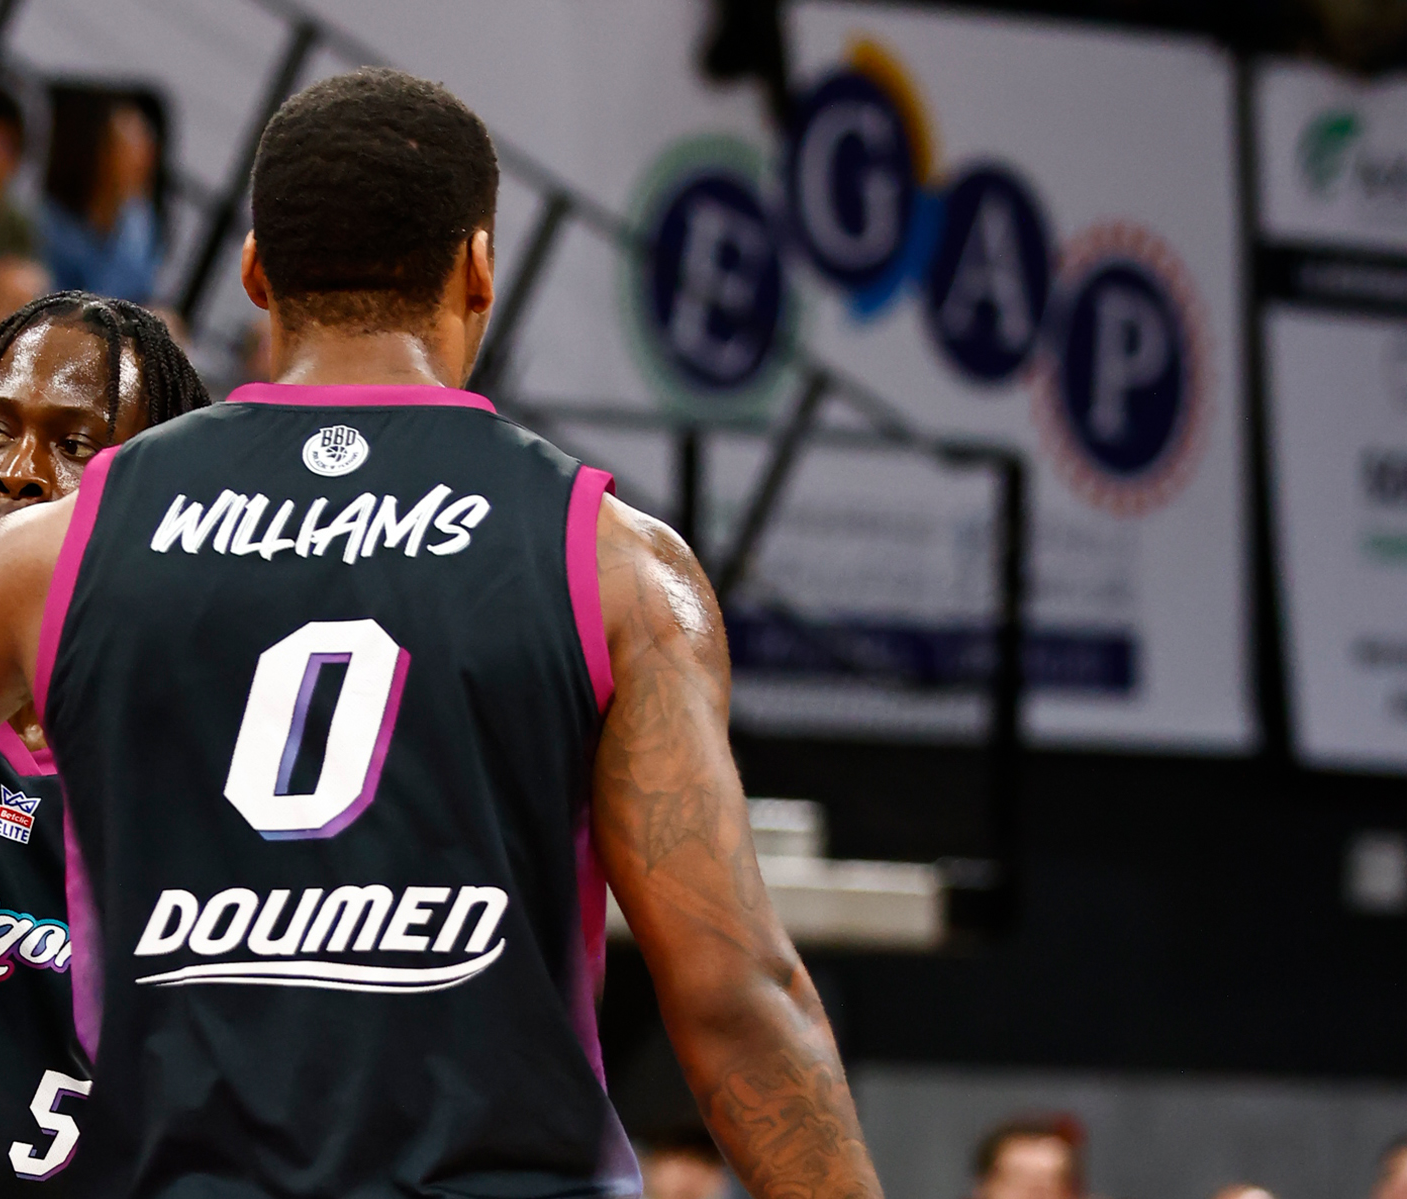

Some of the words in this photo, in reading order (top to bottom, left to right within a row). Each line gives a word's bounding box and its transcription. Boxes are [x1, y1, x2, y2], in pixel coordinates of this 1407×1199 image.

[670, 102, 1171, 440] EGAP
[320, 427, 356, 447] BBD
[150, 484, 491, 564] WILLIAMS
[223, 618, 411, 841] 0
[0, 809, 30, 826] Betclic
[134, 884, 508, 956] DOUMEN
[8, 1069, 93, 1182] 5
